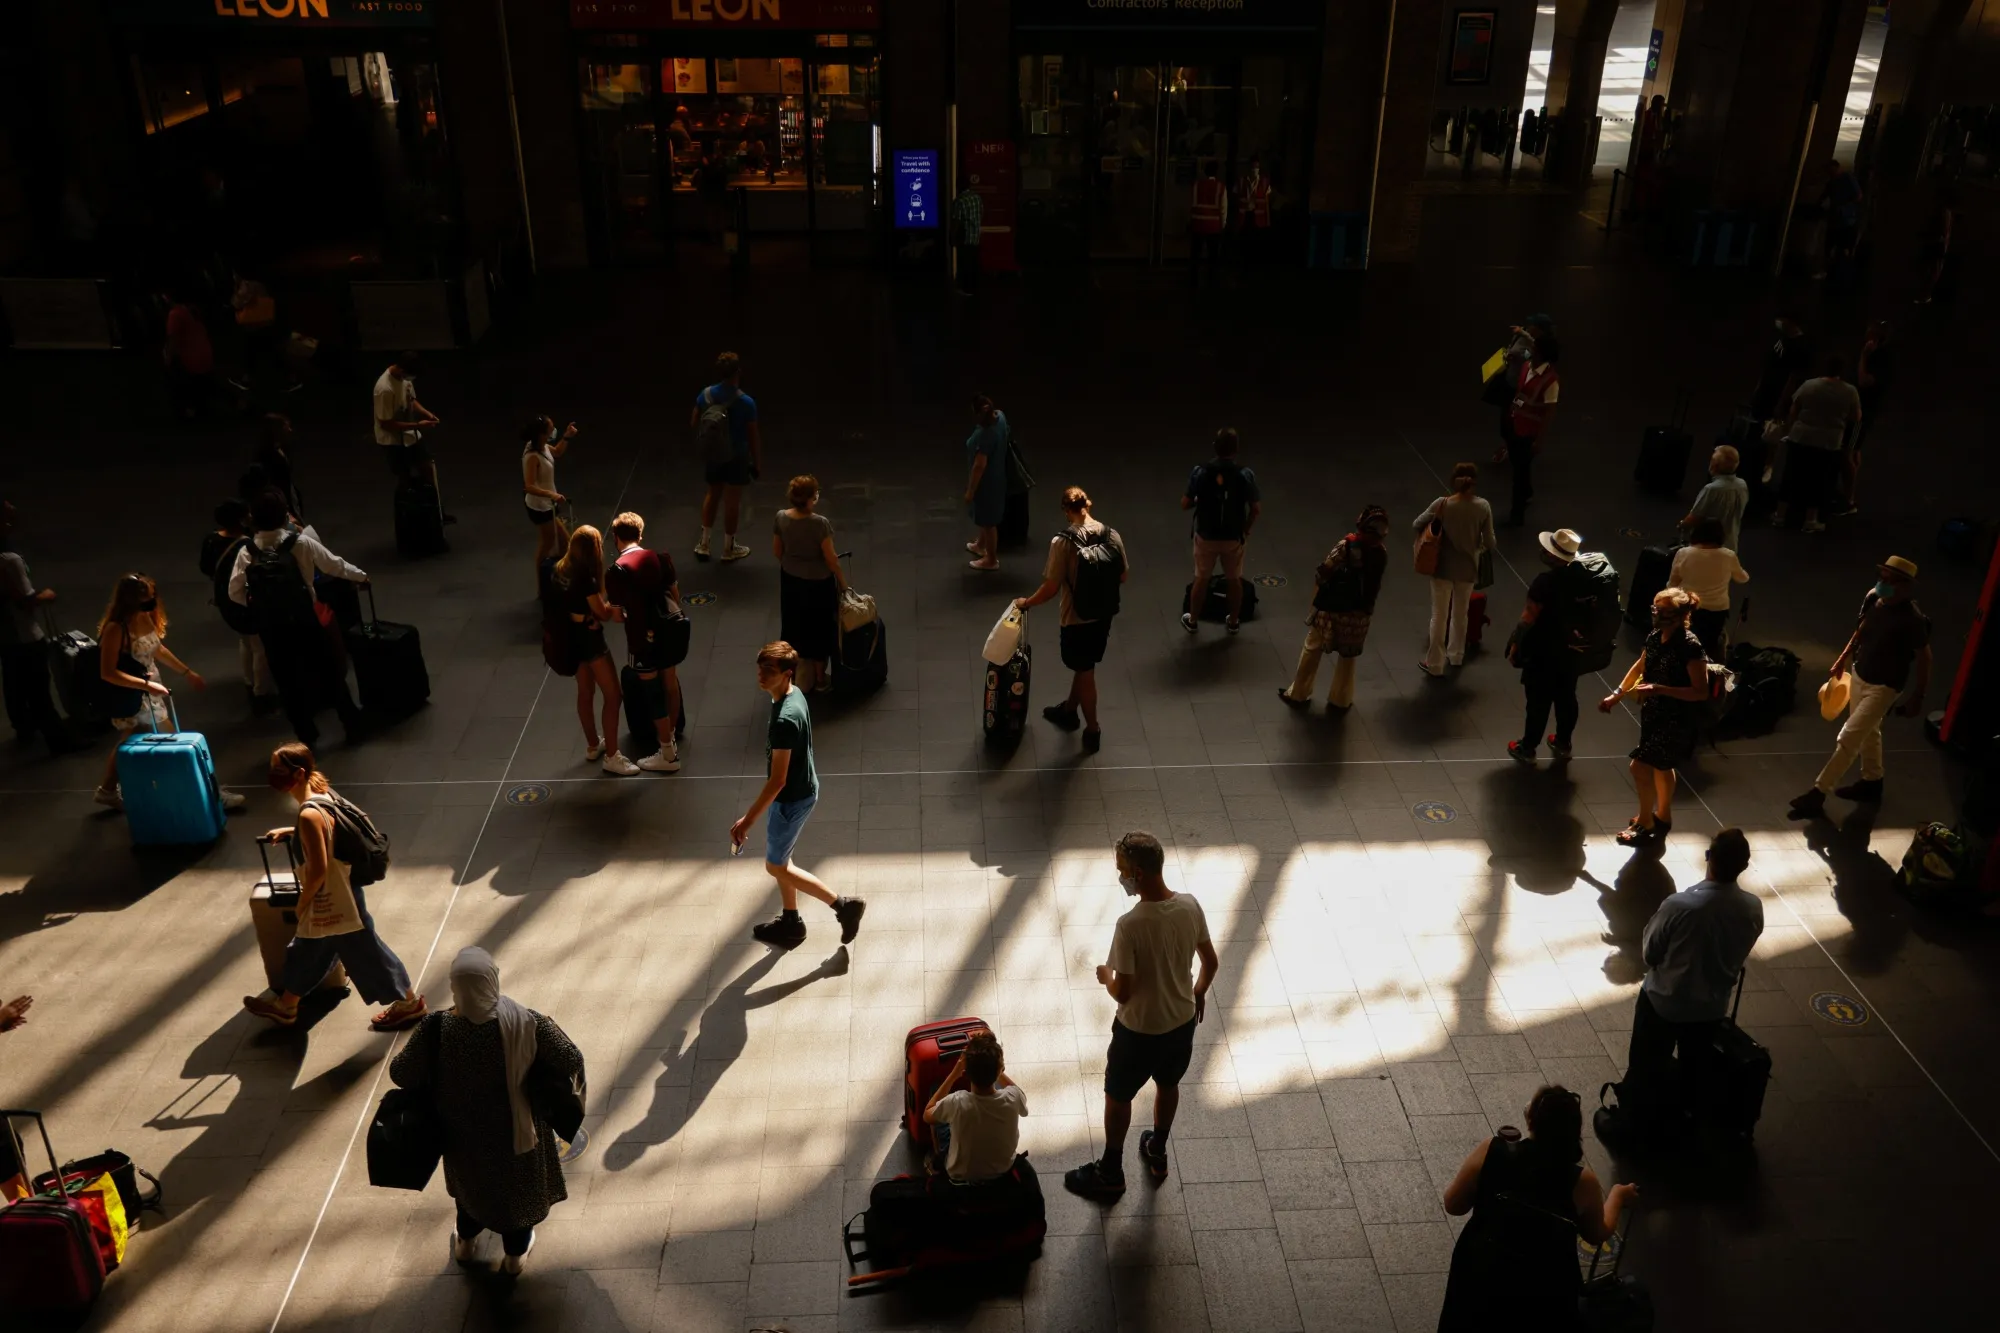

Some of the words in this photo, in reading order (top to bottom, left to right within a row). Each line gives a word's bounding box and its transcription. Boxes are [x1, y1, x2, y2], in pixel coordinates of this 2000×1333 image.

[388, 2, 423, 12] FOOD
[671, 0, 781, 21] LEON
[1087, 0, 1169, 9] Contractors
[1175, 0, 1244, 11] Reception
[974, 143, 1005, 154] LNER
